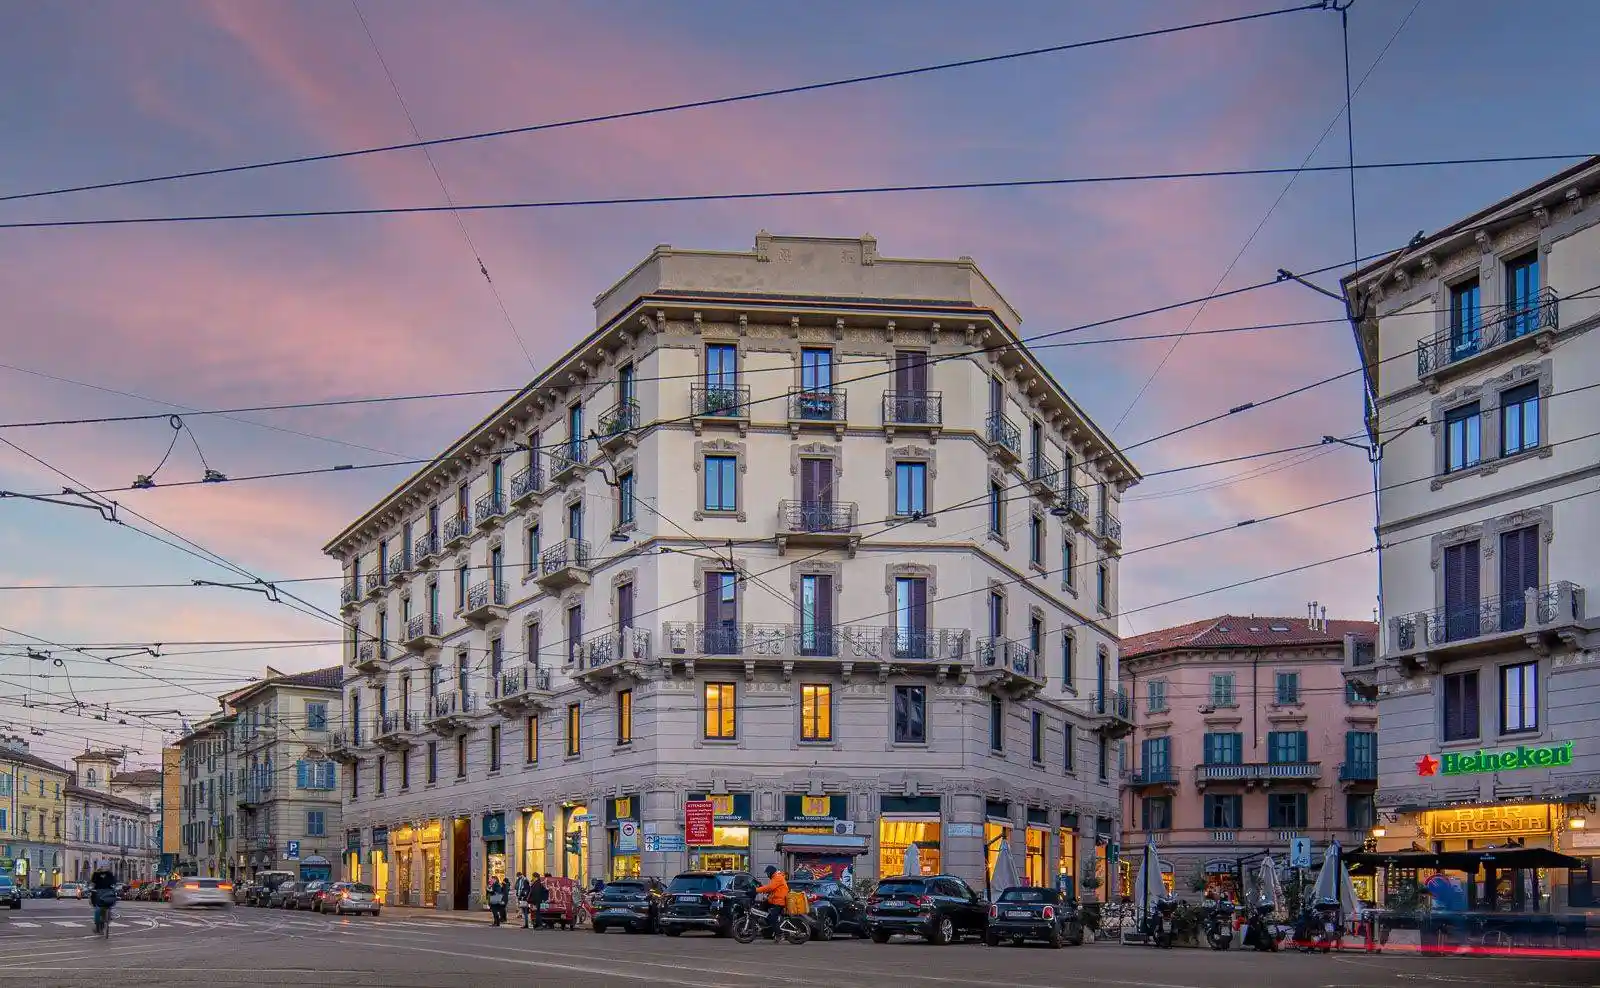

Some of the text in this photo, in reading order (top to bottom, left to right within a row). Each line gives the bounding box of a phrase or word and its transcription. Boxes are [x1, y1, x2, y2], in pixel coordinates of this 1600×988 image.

[1440, 744, 1572, 776] Heineken
[1456, 806, 1523, 821] BAR
[1440, 817, 1543, 833] MAGENTA
[290, 843, 297, 851] P
